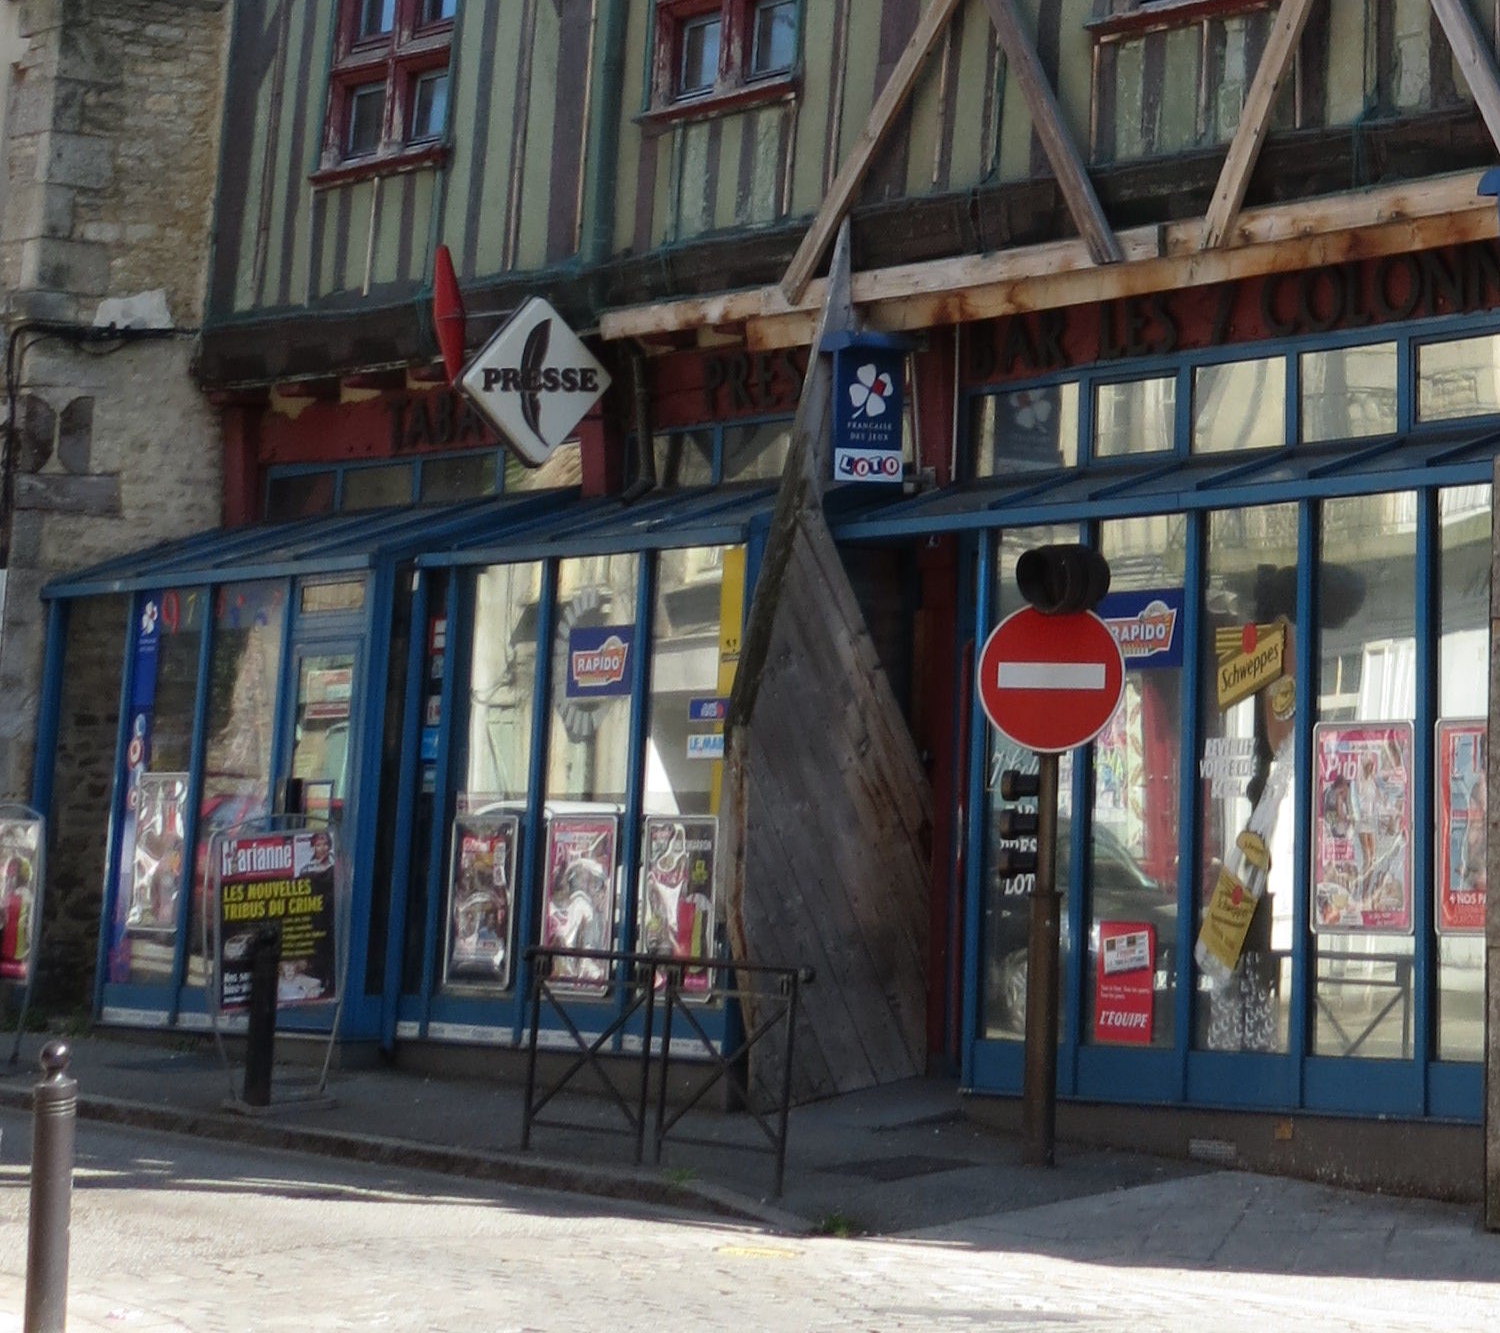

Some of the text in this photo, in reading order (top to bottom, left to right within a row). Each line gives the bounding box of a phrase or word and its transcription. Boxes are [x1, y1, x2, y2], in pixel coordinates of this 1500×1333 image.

[1097, 292, 1179, 363] LES
[482, 366, 600, 393] PRESSE
[704, 346, 803, 411] PRES
[388, 393, 481, 448] TABA
[839, 454, 900, 478] LOTO
[1111, 623, 1167, 642] RAPIDO
[576, 655, 621, 672] RAPIDO
[1220, 643, 1280, 693] Schweppes
[222, 839, 292, 876] Marianne
[224, 878, 313, 903] LES NOUVELLES
[1003, 873, 1036, 895] LOT
[224, 895, 324, 921] TRIBUS DU CRIME
